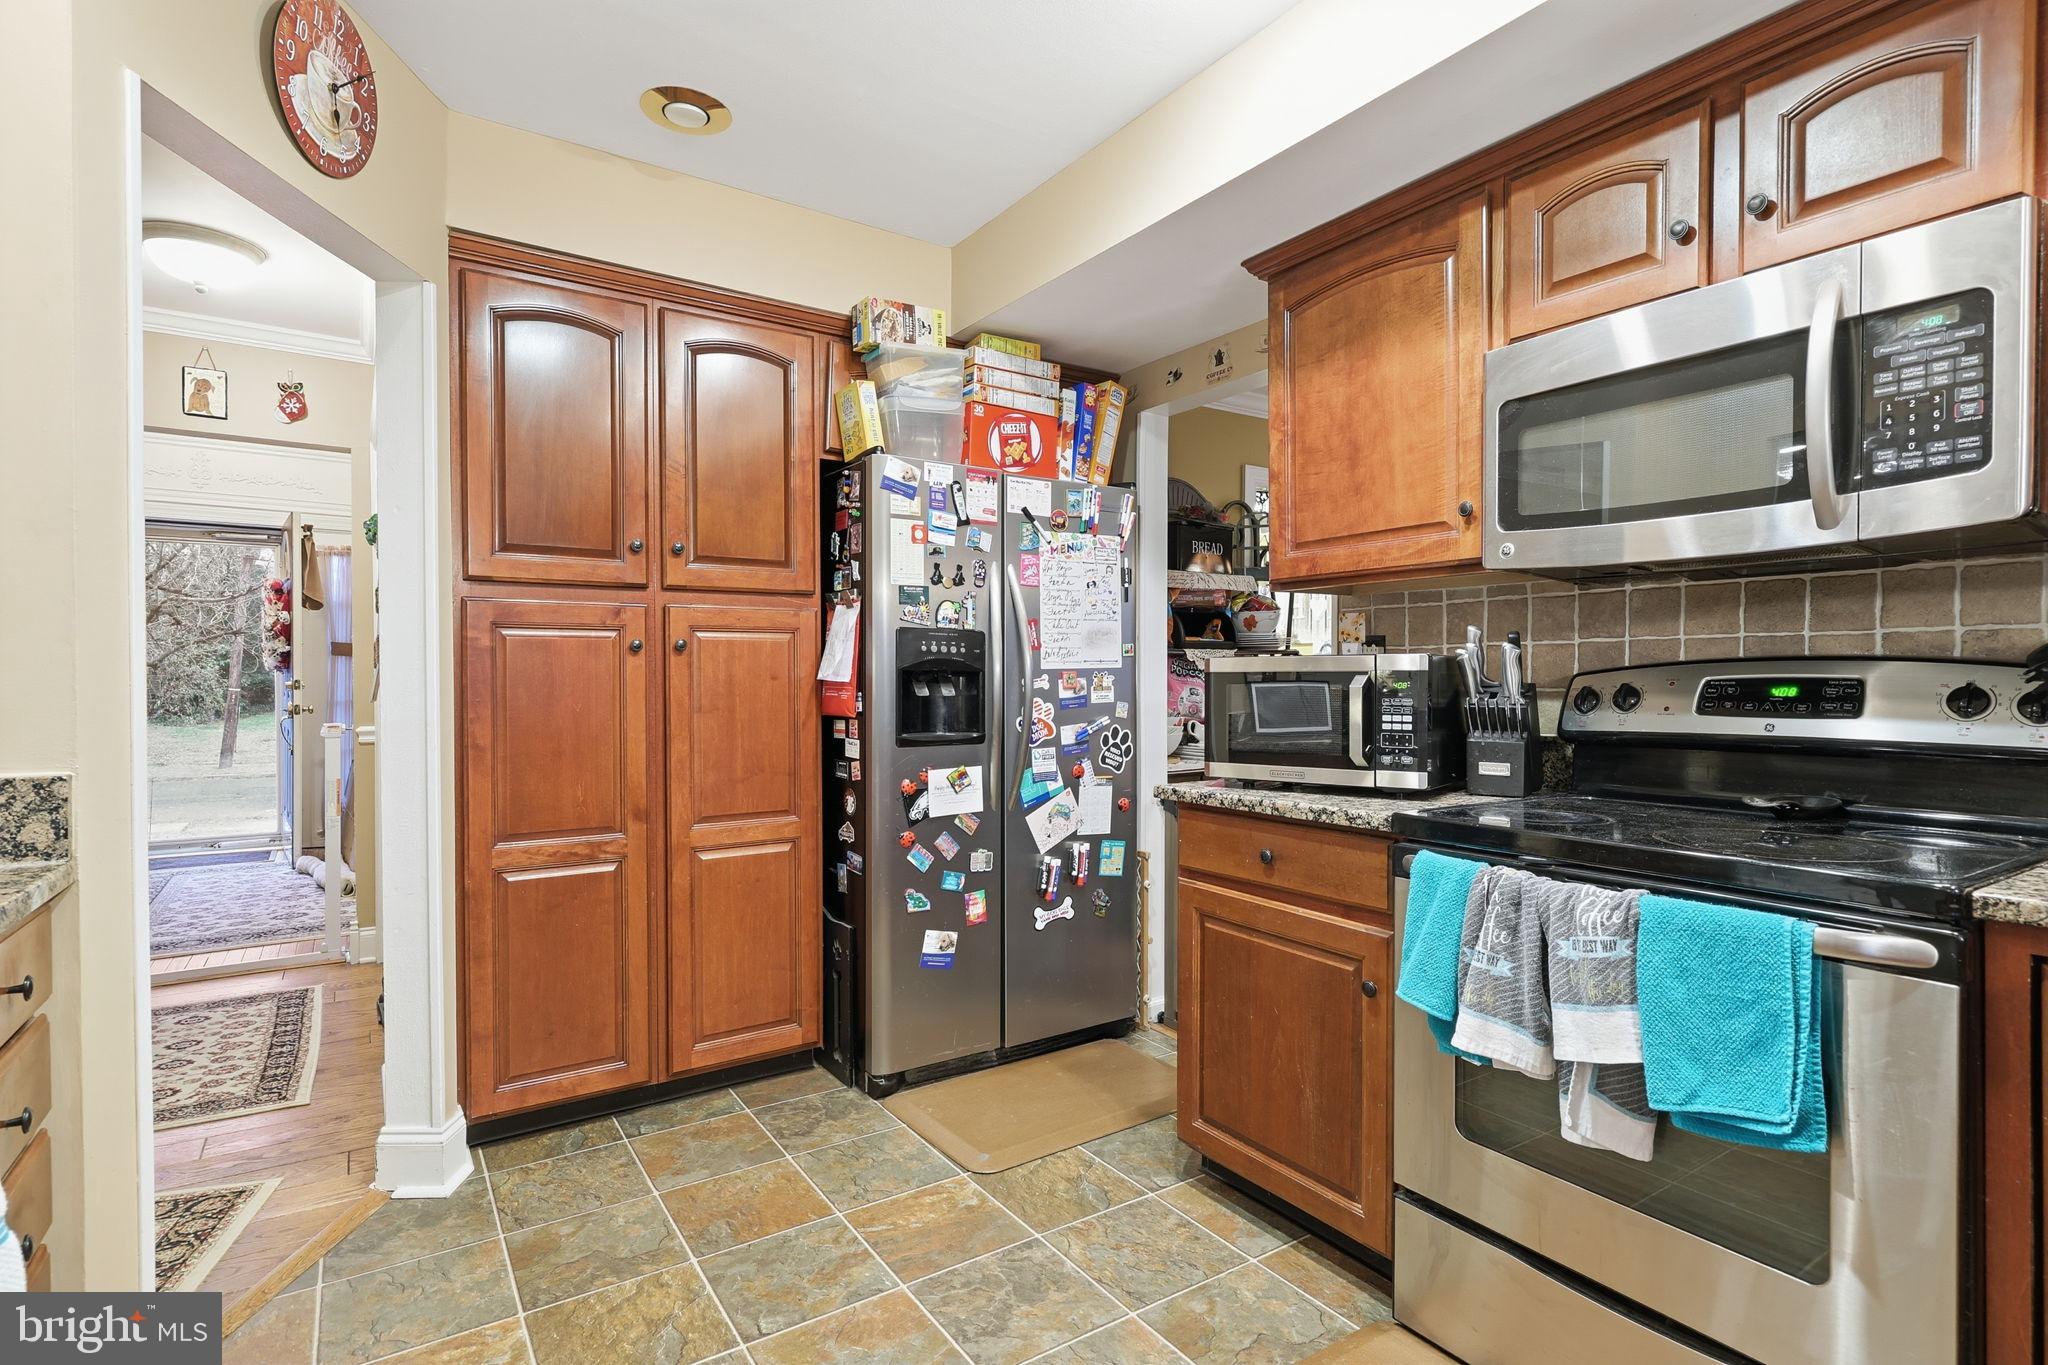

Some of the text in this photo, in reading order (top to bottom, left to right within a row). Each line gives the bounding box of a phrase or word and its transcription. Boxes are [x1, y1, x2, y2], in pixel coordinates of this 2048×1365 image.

[314, 4, 323, 30] 11
[295, 14, 308, 42] 10
[333, 14, 345, 41] 12
[286, 39, 296, 61] 9
[353, 46, 360, 67] 1
[287, 75, 297, 98] 8
[361, 78, 369, 97] 2
[302, 111, 310, 130] 7
[362, 112, 370, 132] 3
[320, 136, 328, 156] 6
[355, 135, 362, 155] 4
[340, 146, 347, 163] 5
[1206, 368, 1226, 380] COFFEE
[974, 404, 984, 413] 30
[1909, 400, 1916, 408] 2
[1885, 431, 1892, 439] 7
[1909, 428, 1916, 436] 8
[1933, 424, 1940, 432] 9
[1050, 541, 1083, 556] MENU
[1192, 540, 1224, 556] BREAD
[1032, 722, 1044, 732] DOG
[1032, 729, 1049, 742] MOM
[1105, 751, 1122, 762] RESCUED
[1110, 746, 1121, 754] WHO
[1577, 897, 1625, 937] Coffee
[1600, 939, 1618, 953] WAY
[1486, 953, 1501, 967] WAY
